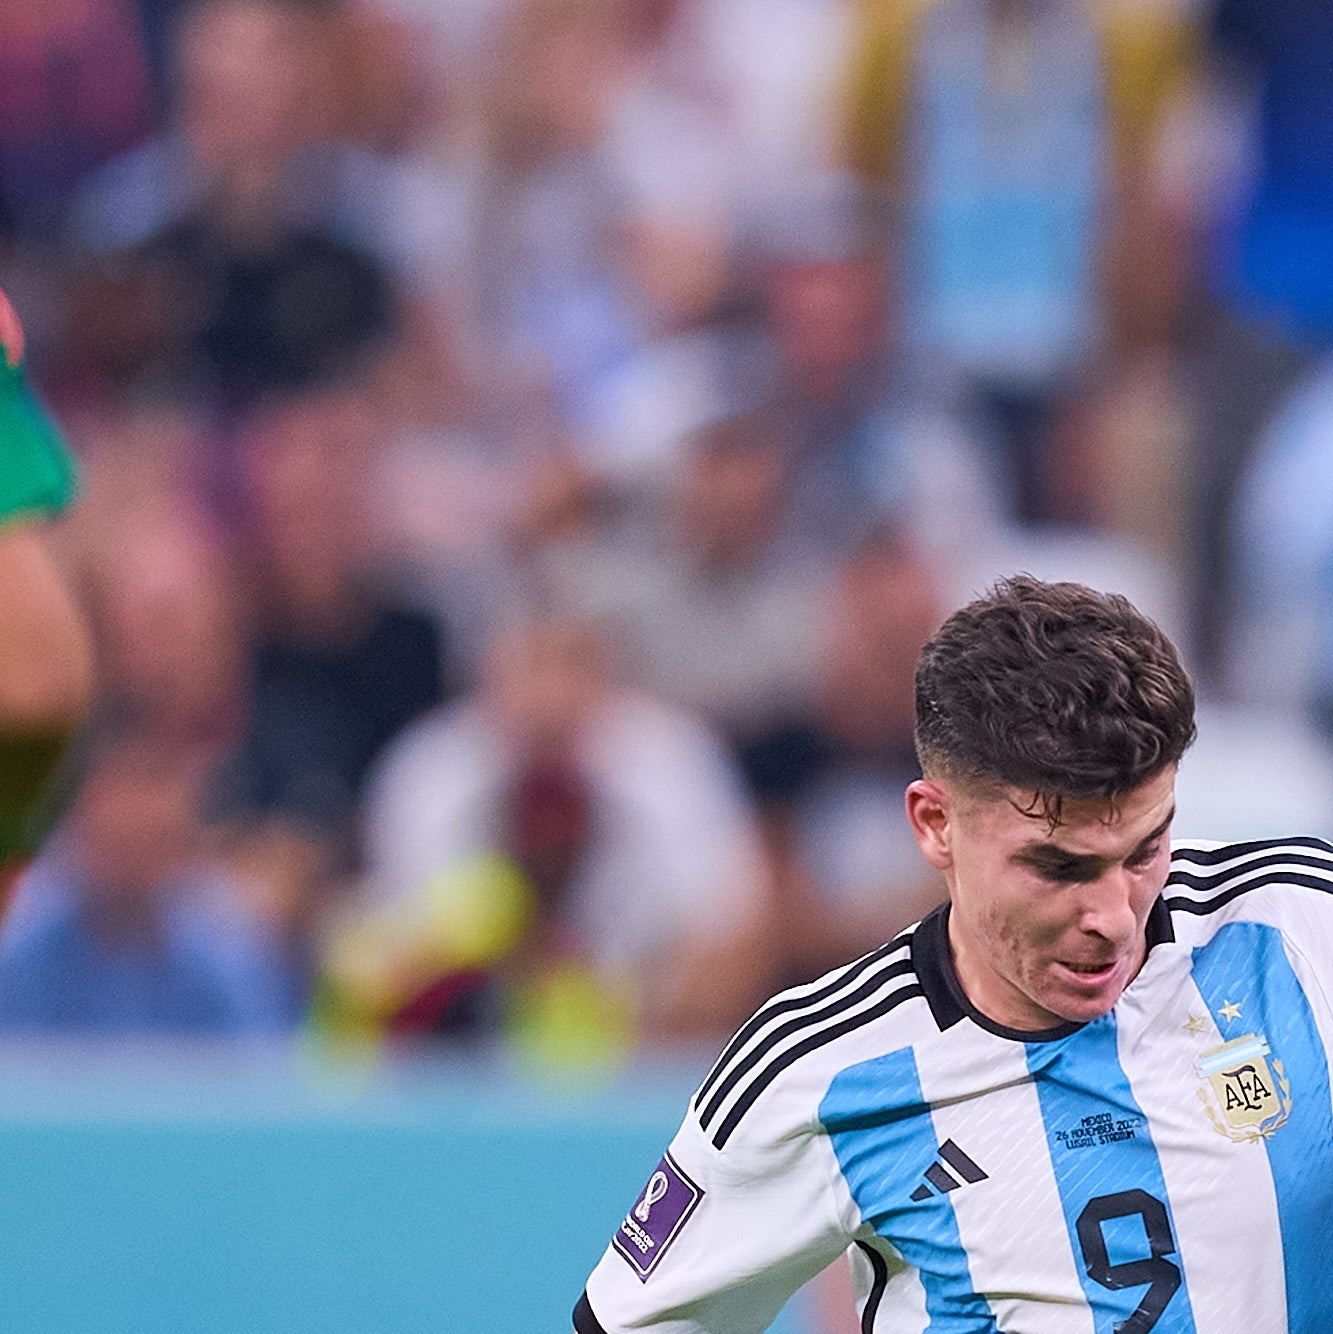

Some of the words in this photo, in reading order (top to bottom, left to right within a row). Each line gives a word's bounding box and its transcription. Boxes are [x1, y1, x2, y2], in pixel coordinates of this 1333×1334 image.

[1222, 1065, 1271, 1111] AFA
[1055, 1131, 1069, 1140] 26
[1071, 1123, 1114, 1138] NOVEMBER
